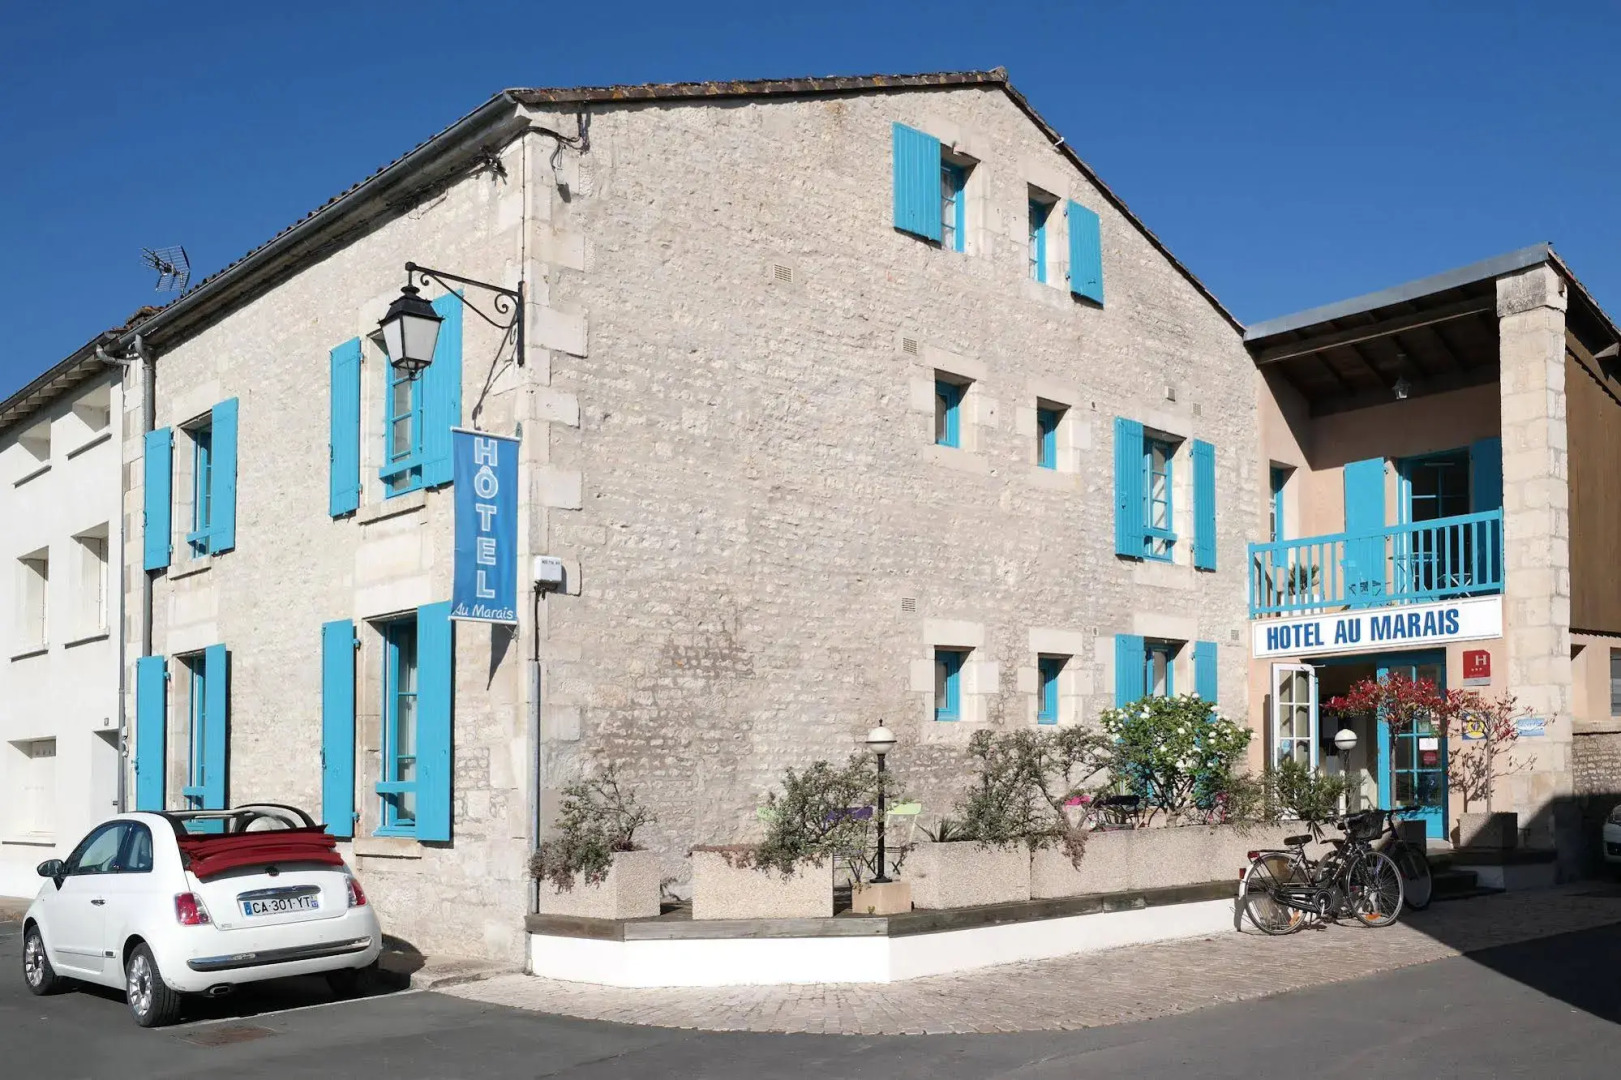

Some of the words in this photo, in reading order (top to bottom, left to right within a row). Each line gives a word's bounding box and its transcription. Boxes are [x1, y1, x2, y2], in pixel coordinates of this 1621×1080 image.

[474, 437, 498, 598] HÔTEL
[453, 602, 468, 616] Au
[472, 604, 514, 619] Marais
[1266, 622, 1324, 650] HOTEL
[1334, 619, 1361, 644] AU
[1370, 608, 1459, 641] MARAIS
[1475, 654, 1487, 666] H
